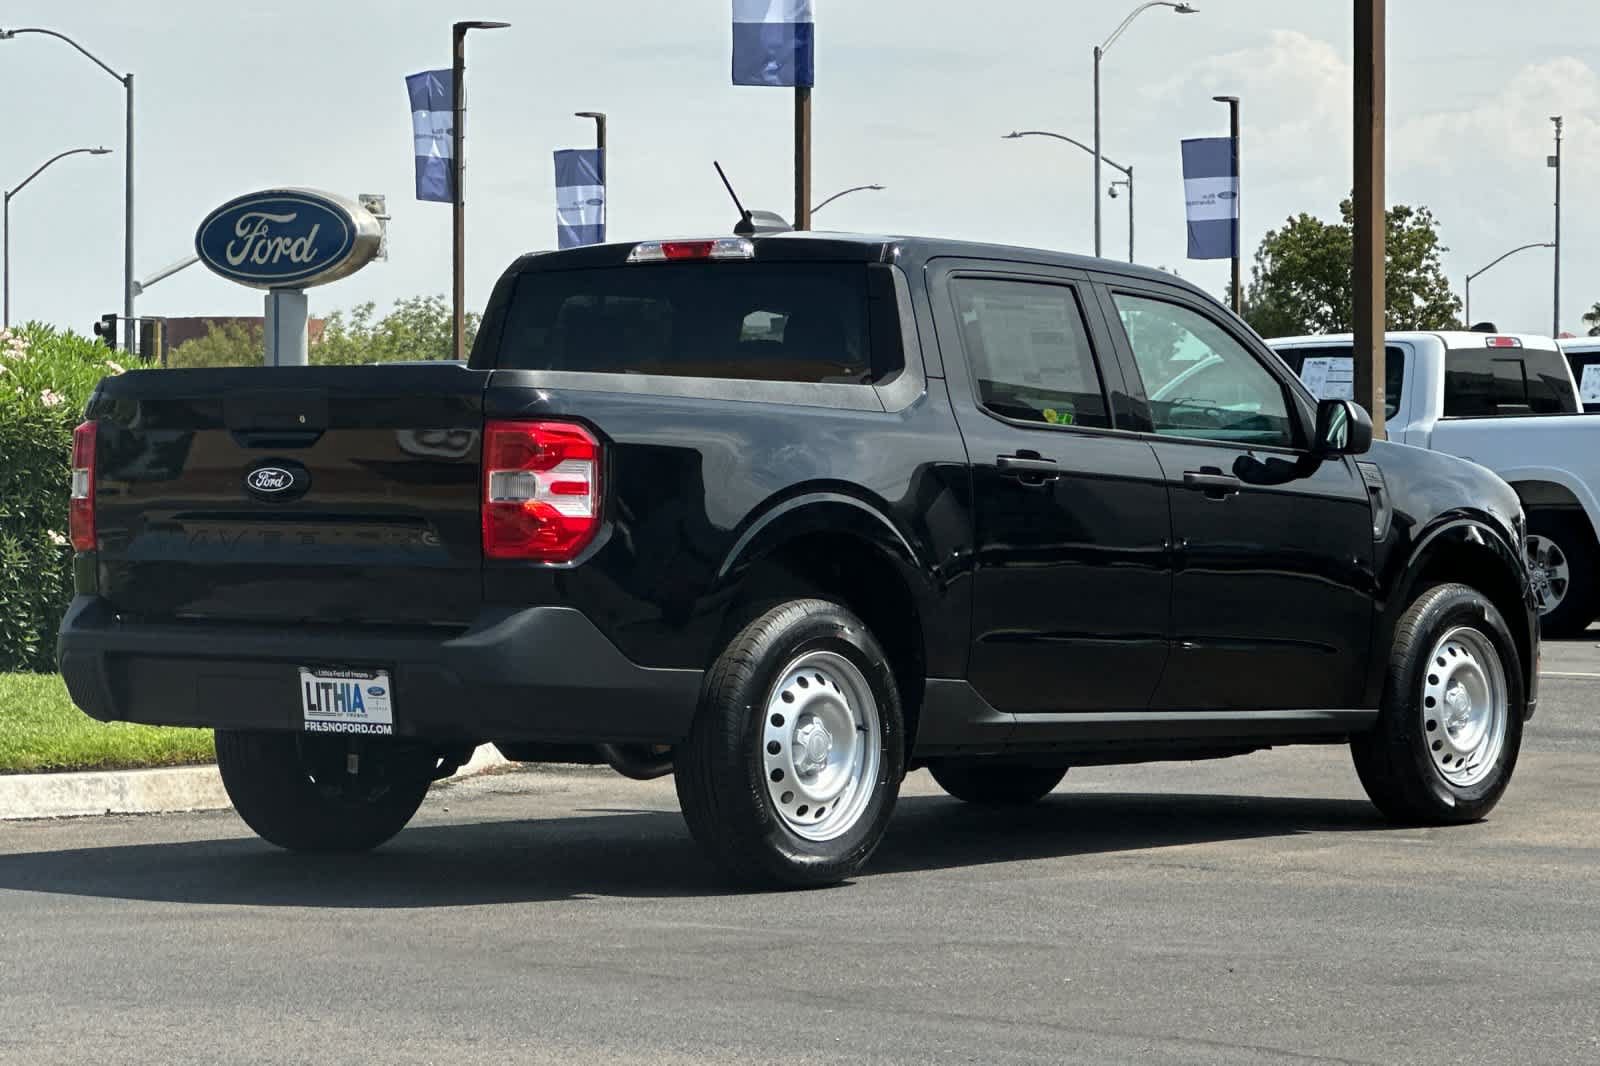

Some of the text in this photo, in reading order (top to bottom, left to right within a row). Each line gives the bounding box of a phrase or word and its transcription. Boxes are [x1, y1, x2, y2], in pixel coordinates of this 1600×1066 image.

[226, 212, 320, 265] Ford
[256, 471, 284, 487] Ford
[305, 681, 366, 713] LITHIA
[304, 721, 393, 735] FRESNOFORD.COM
